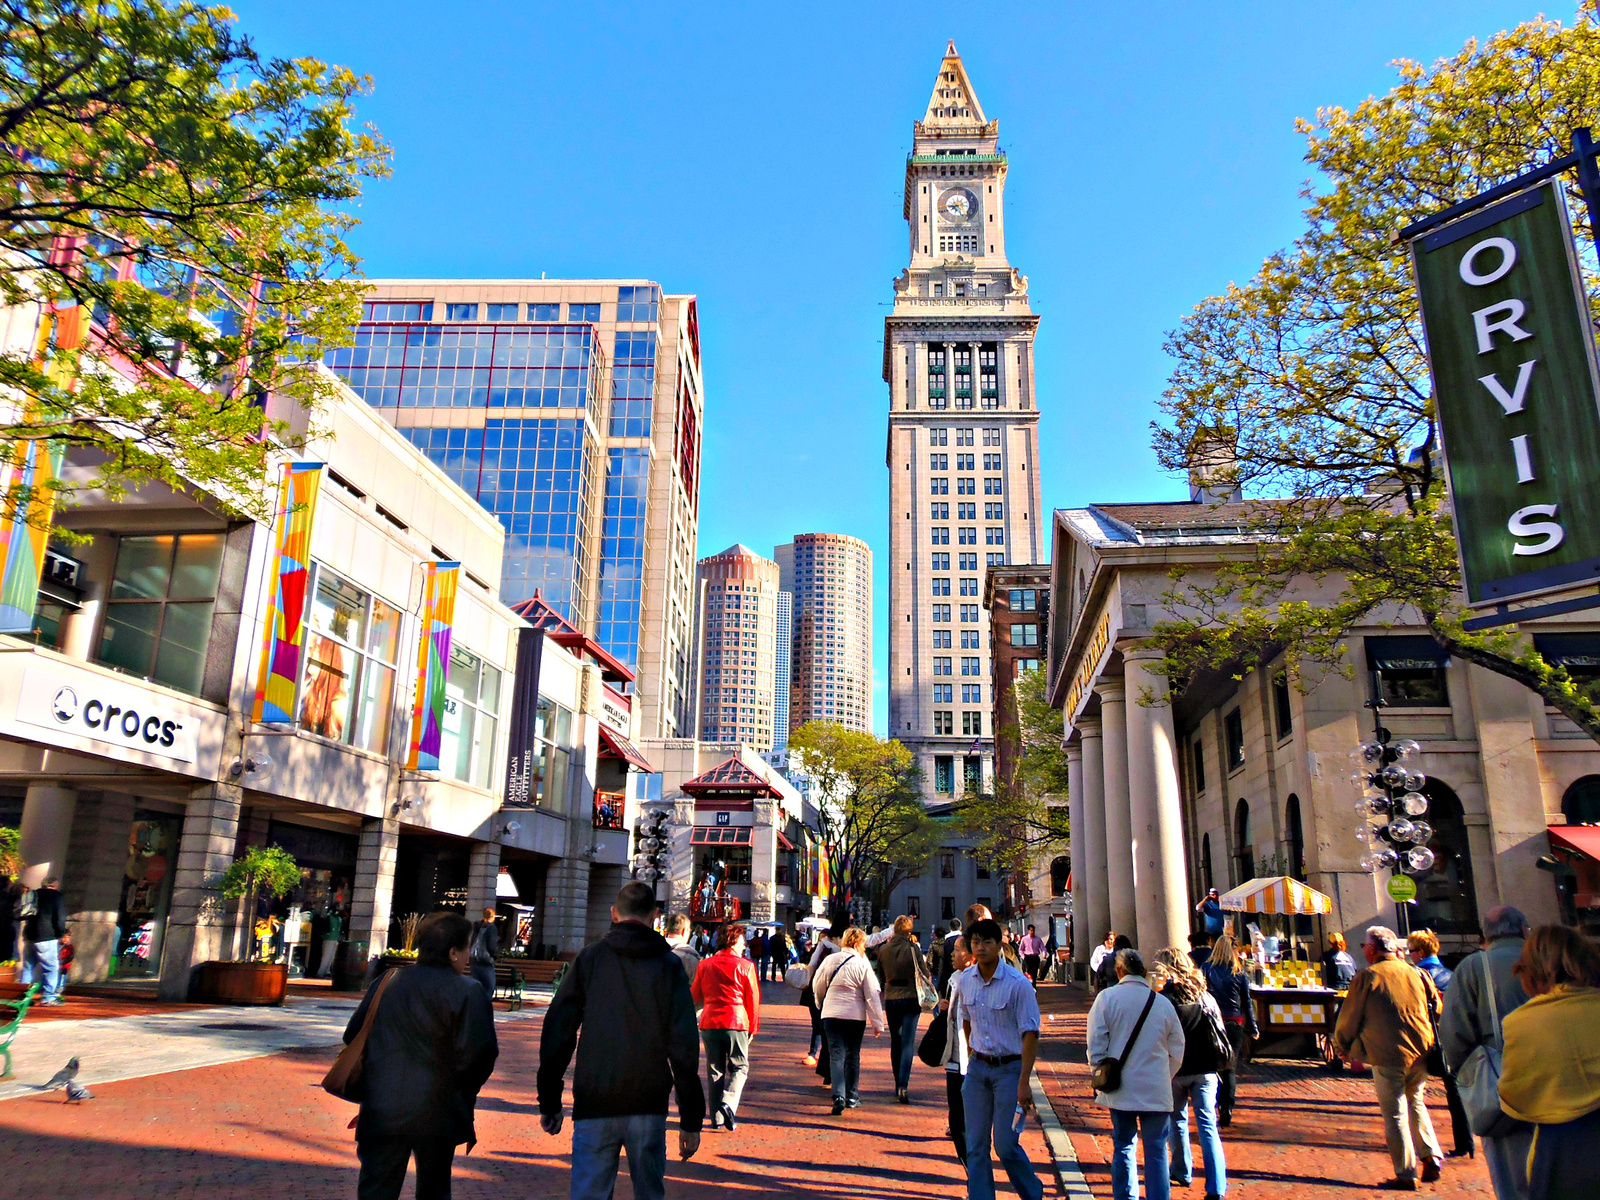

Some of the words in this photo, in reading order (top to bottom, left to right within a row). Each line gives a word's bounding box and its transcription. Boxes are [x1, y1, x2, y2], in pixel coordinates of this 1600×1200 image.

[1460, 237, 1565, 556] ORVIS
[83, 699, 177, 747] crocs
[509, 756, 518, 801] AMERICAN
[515, 774, 523, 802] EAGLE
[522, 749, 531, 802] OUTFITTERS
[718, 814, 728, 822] GAP
[1390, 879, 1411, 887] Wi-Fi
